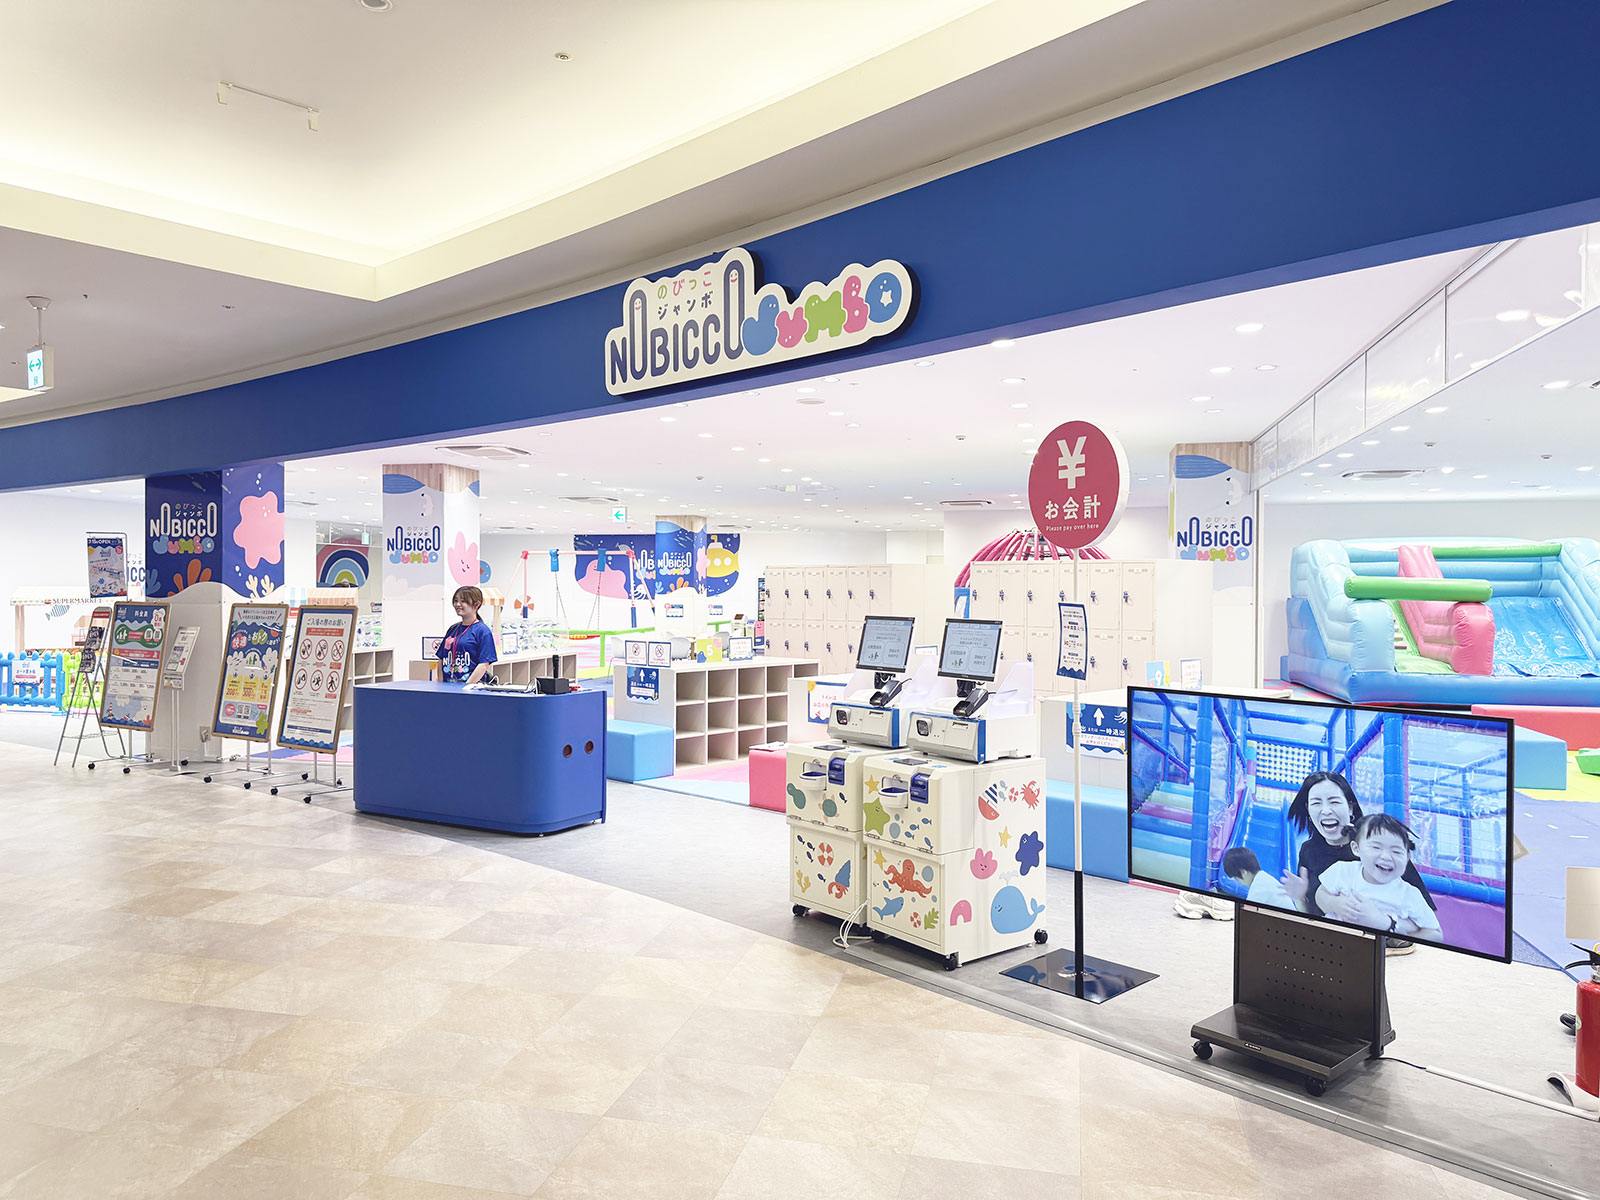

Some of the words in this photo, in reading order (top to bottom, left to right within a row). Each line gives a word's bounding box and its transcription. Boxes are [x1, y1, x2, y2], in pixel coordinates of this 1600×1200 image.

[657, 270, 712, 300] のびっこ
[657, 290, 714, 320] ジャンボ
[610, 259, 745, 386] NOBICCO
[742, 271, 903, 356] JUMBO
[150, 502, 217, 537] NOBICCO
[1044, 494, 1101, 520] お会計
[153, 534, 215, 554] JUMBO
[387, 526, 440, 551] NOBICCO
[1177, 516, 1252, 547] NOBICCO
[389, 549, 439, 564] JUMBO
[658, 552, 692, 568] NOBICCO
[1180, 545, 1250, 561] JUMBO
[443, 651, 470, 667] NOCCO
[1155, 670, 1163, 687] 9
